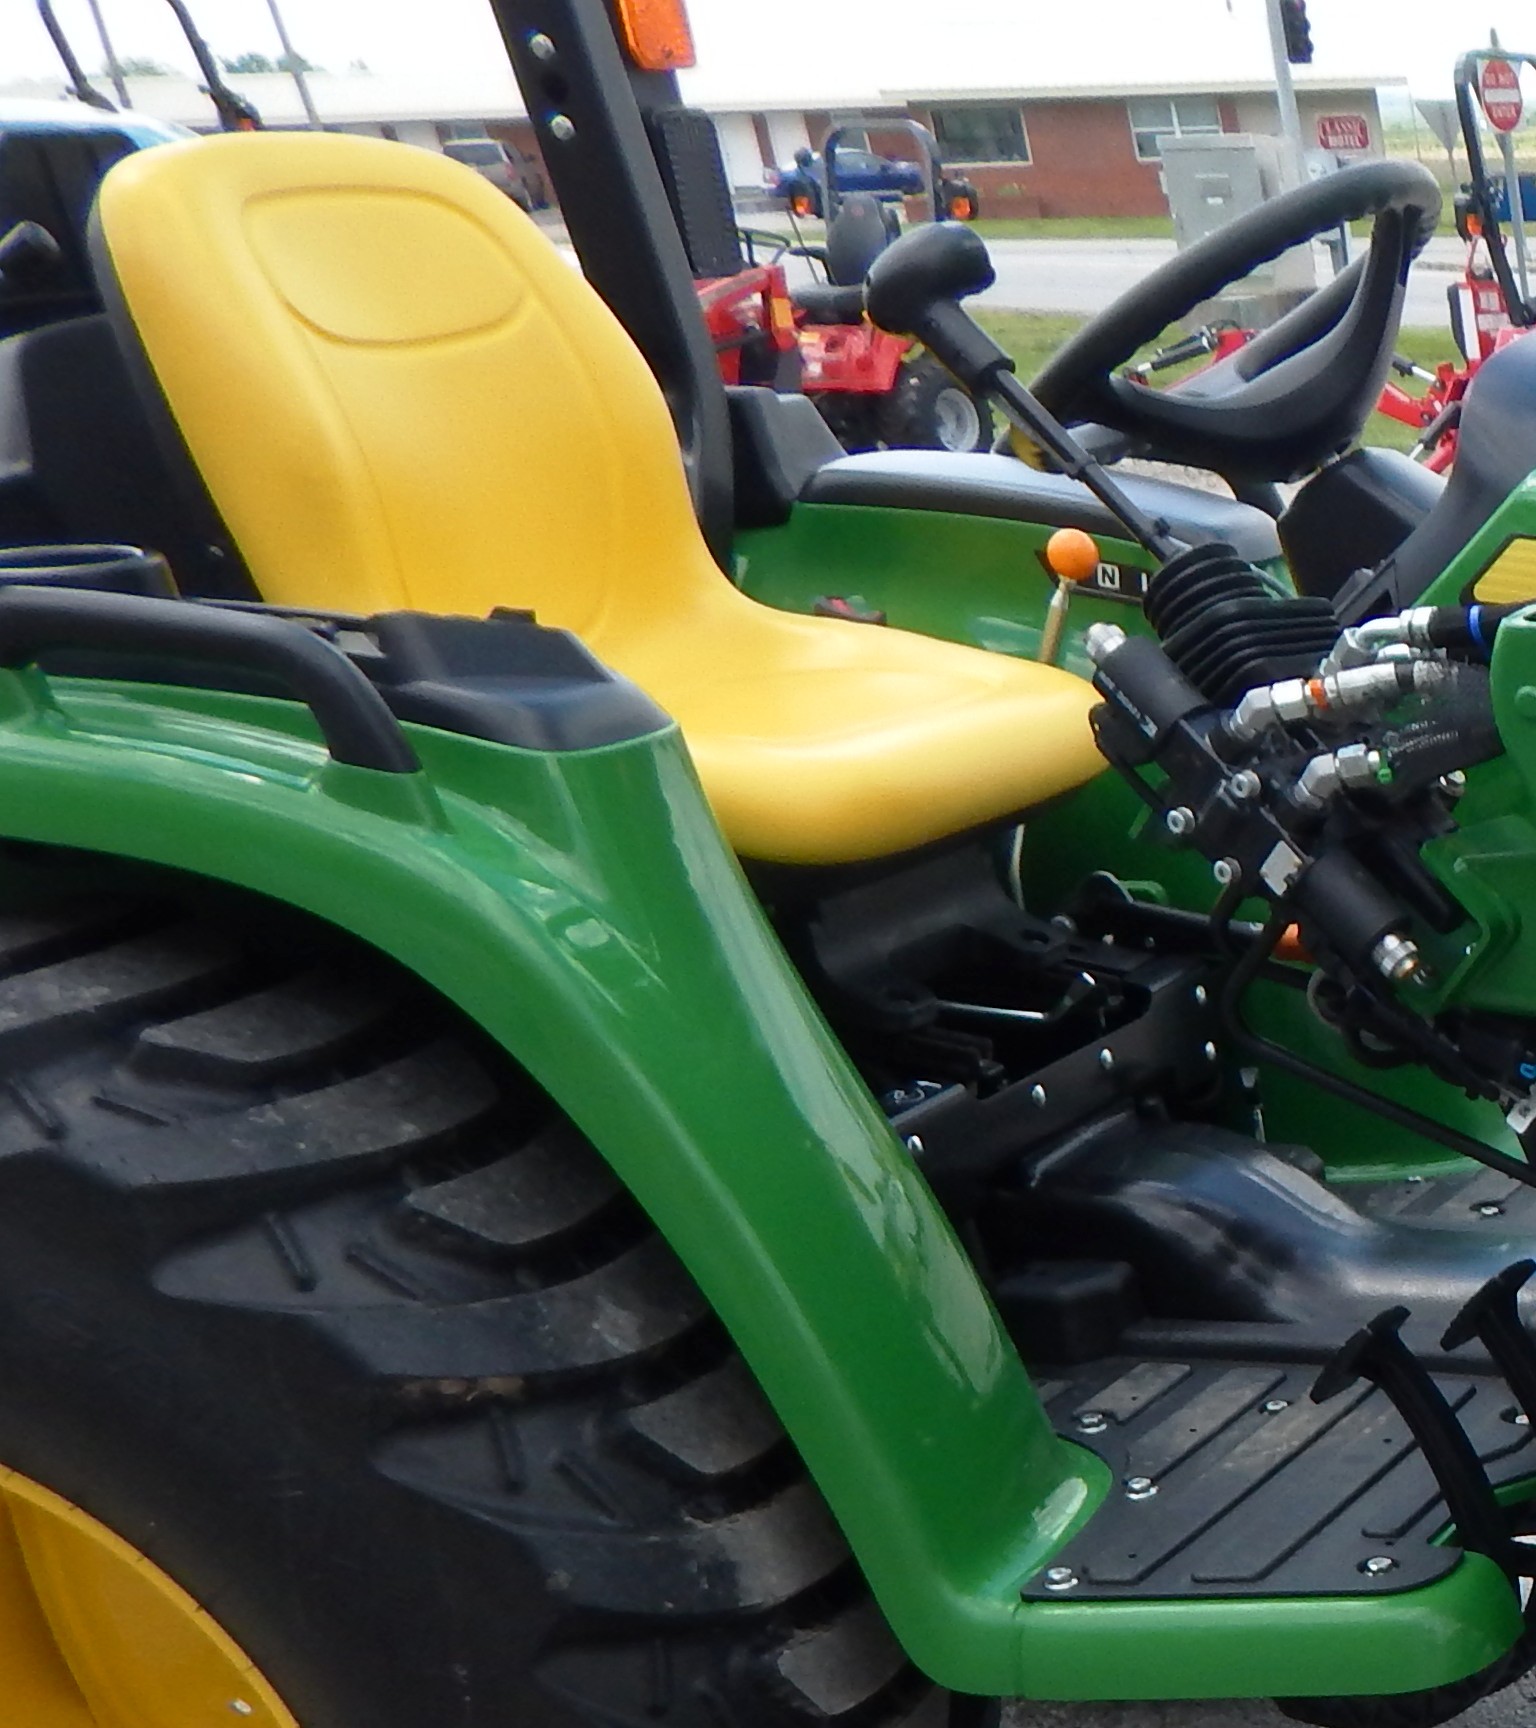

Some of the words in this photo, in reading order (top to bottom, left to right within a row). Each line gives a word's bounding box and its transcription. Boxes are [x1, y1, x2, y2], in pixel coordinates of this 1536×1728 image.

[1491, 103, 1517, 118] ENTER
[1328, 135, 1361, 147] MOTEL
[1101, 566, 1116, 586] N
